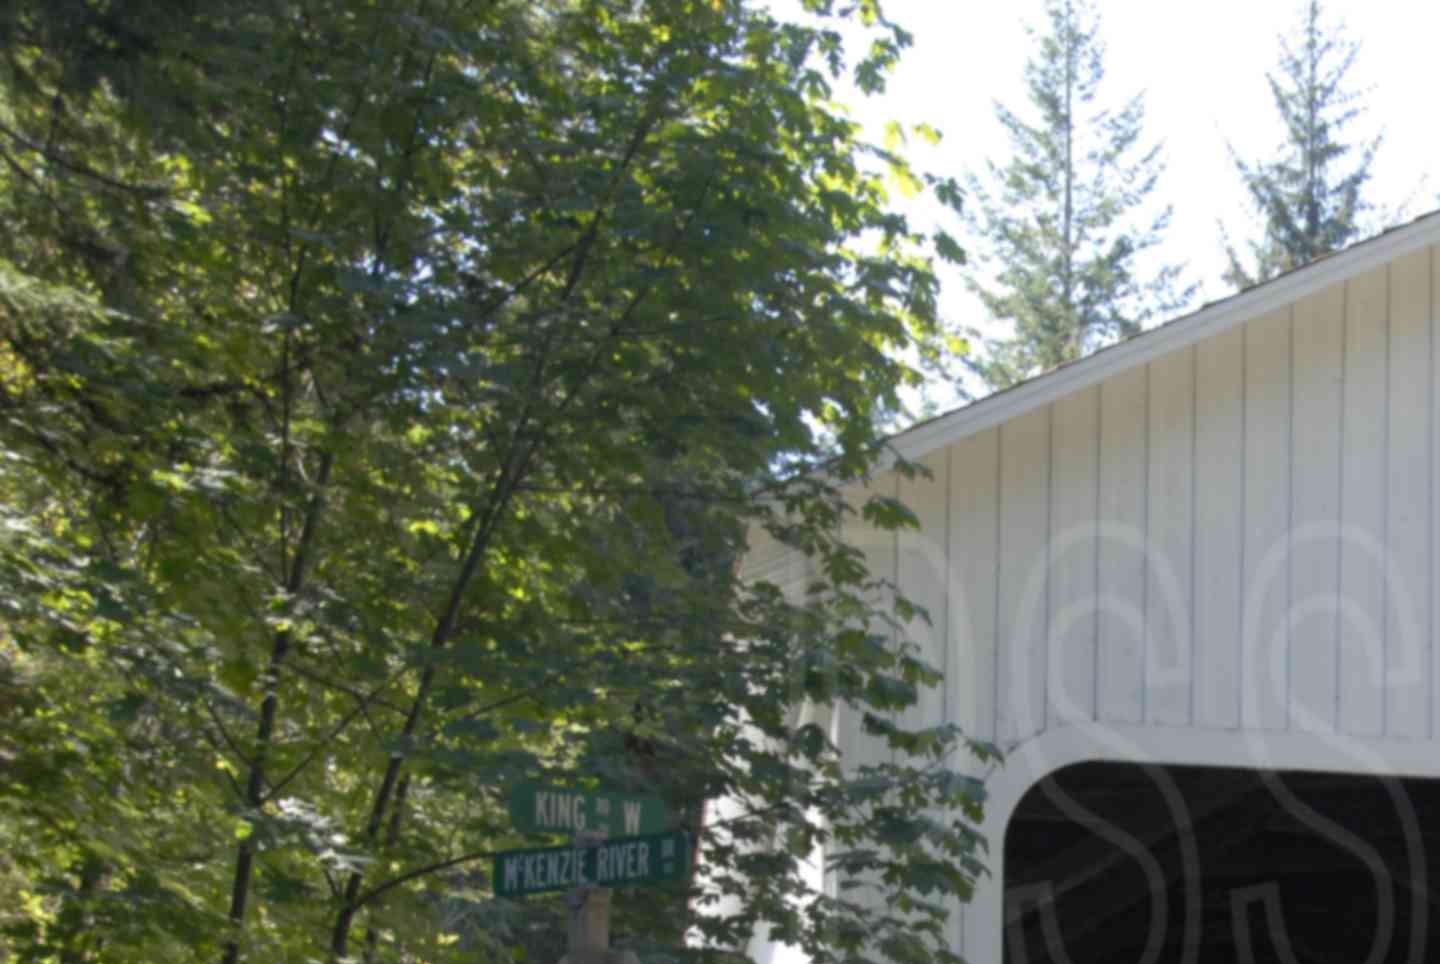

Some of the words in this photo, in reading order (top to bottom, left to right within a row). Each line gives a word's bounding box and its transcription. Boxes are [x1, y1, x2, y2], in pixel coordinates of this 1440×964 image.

[535, 792, 586, 830] KING
[623, 801, 641, 836] W
[597, 841, 649, 881] RIVER
